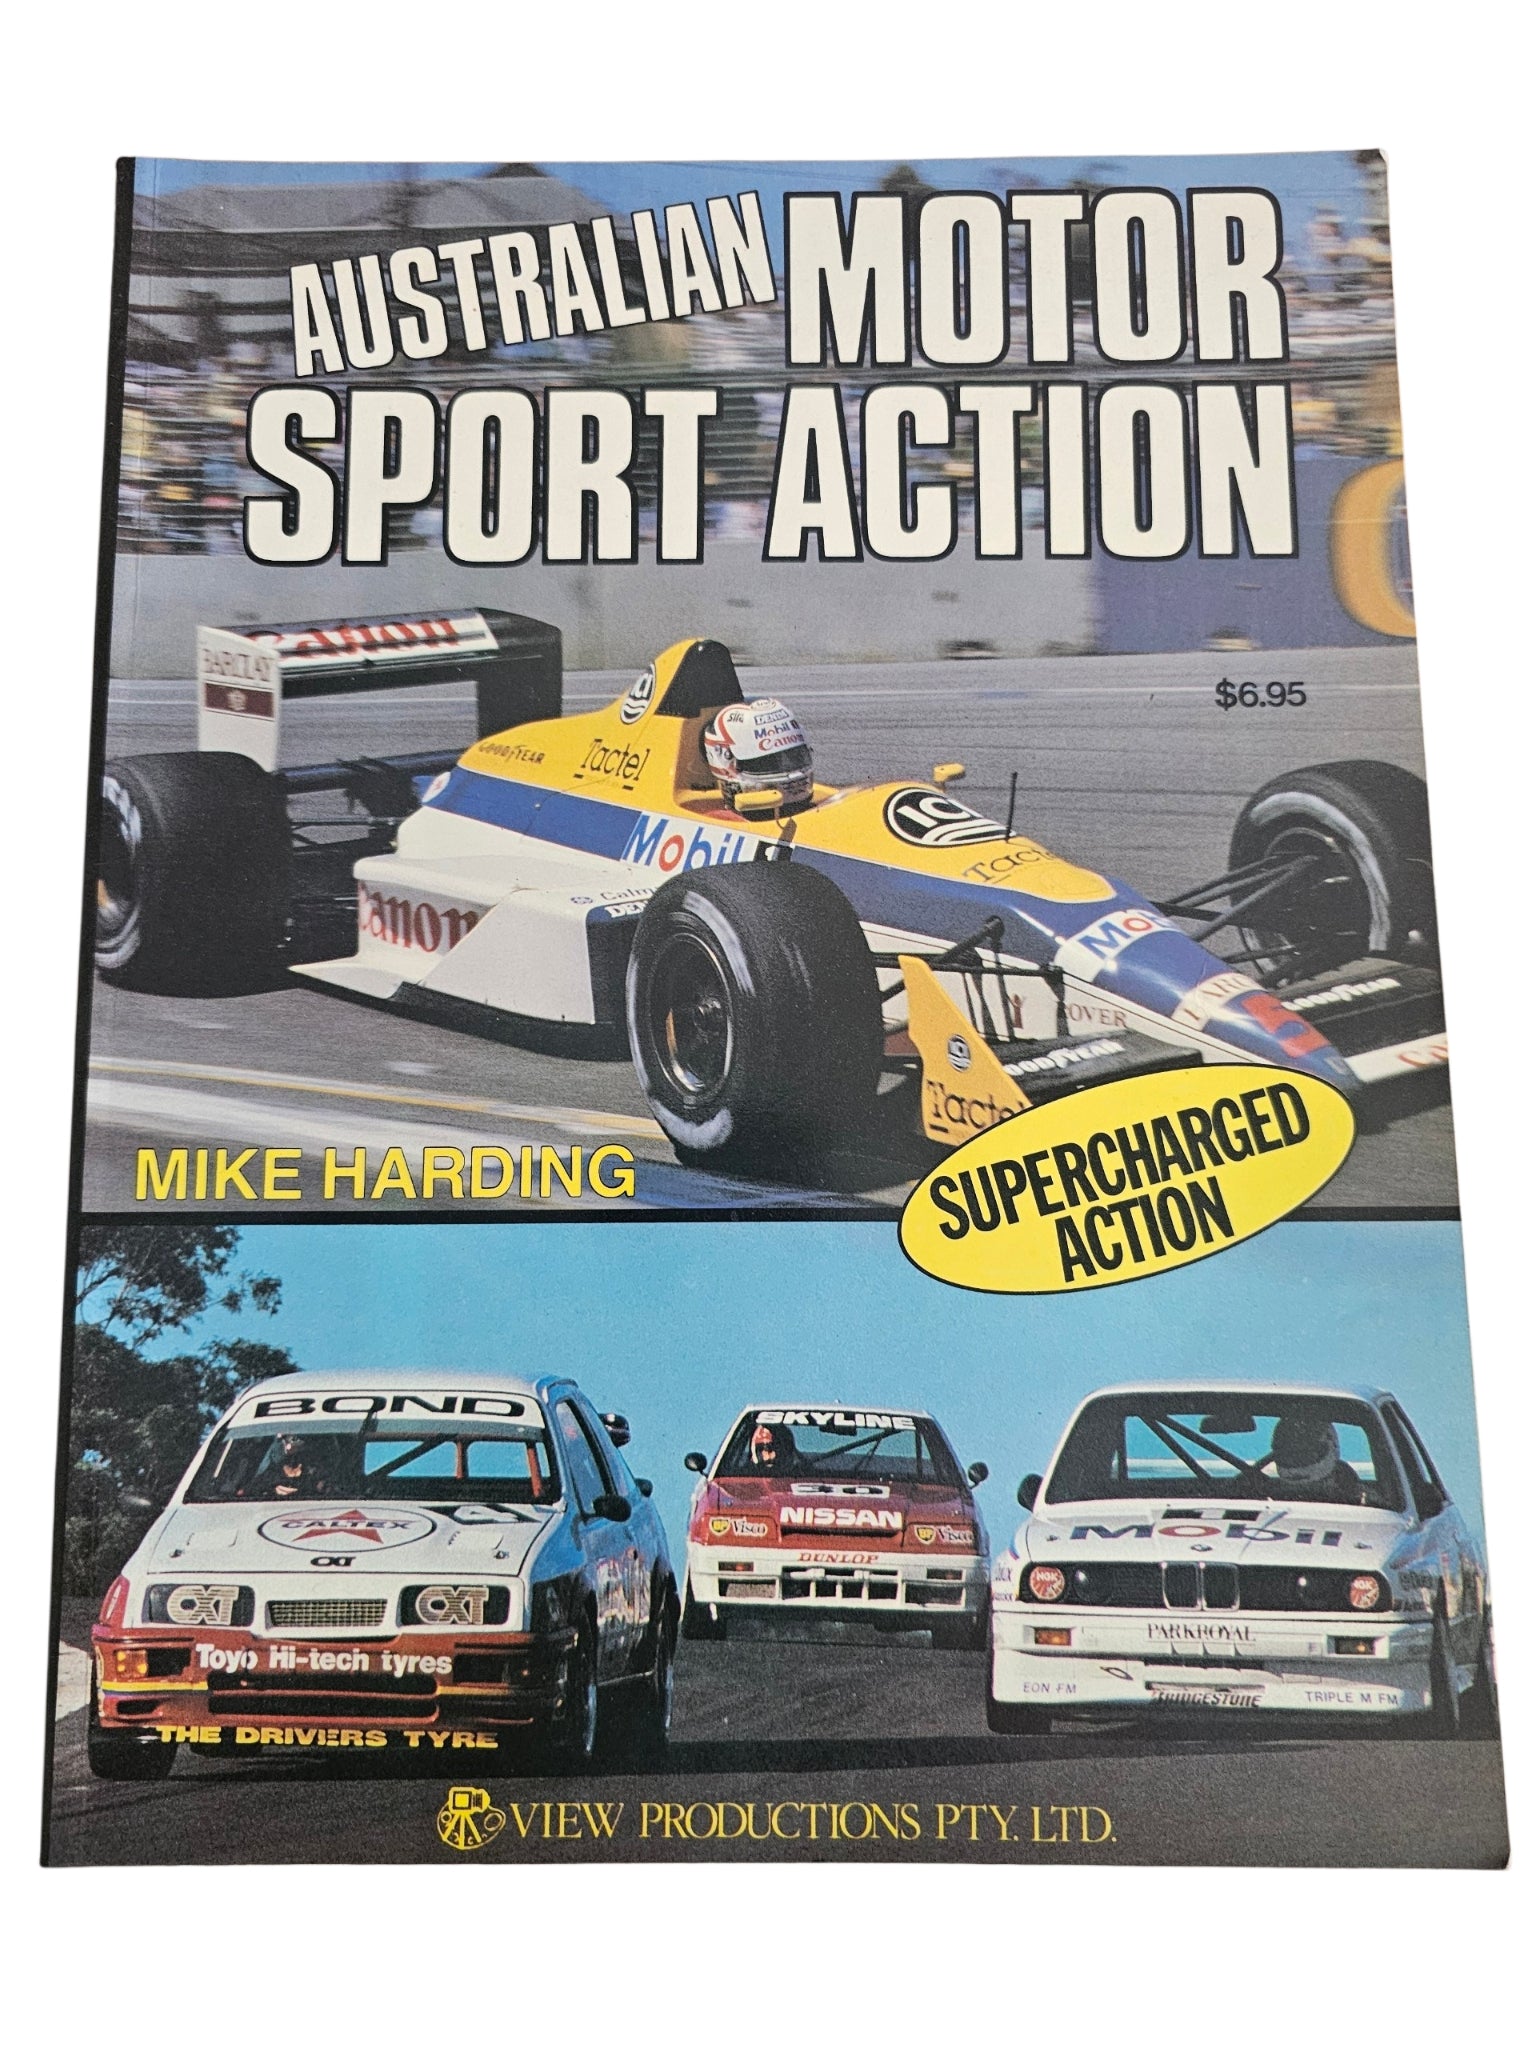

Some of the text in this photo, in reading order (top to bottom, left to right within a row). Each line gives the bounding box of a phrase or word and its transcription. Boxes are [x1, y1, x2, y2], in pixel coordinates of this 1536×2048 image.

[289, 186, 1290, 377] AUSTRALIAN MOTOR
[243, 386, 724, 566] SPORT
[762, 381, 1299, 563] ACTION
[1214, 677, 1307, 711] $6.95
[573, 738, 651, 790] Tactel
[896, 796, 972, 829] IC
[621, 813, 746, 873] Mobil
[1066, 1003, 1128, 1028] OVER
[1002, 1038, 1125, 1076] OODYEAR
[135, 1144, 636, 1200] MIKE HARDING
[929, 1082, 1310, 1241] SUPERCHARGED
[1054, 1175, 1235, 1283] ACTION
[253, 1395, 526, 1418] BOND
[755, 1410, 917, 1431] SKYLINE
[281, 1519, 413, 1530] CALTEX
[732, 1518, 767, 1536] Visco
[780, 1506, 902, 1530] NISSAN
[1070, 1523, 1343, 1547] Mobil
[797, 1552, 880, 1564] DUNLOP
[1147, 1622, 1257, 1642] PARKROYAL
[196, 1643, 453, 1678] Toyo Hi-tech tyres
[1056, 1682, 1077, 1695] FM
[1305, 1690, 1400, 1706] TRIPLE M FM
[156, 1725, 499, 1750] THE DRIVERS TYRE
[509, 1802, 1118, 1843] VIEW PRODUCTIONS PTY. LTD.
